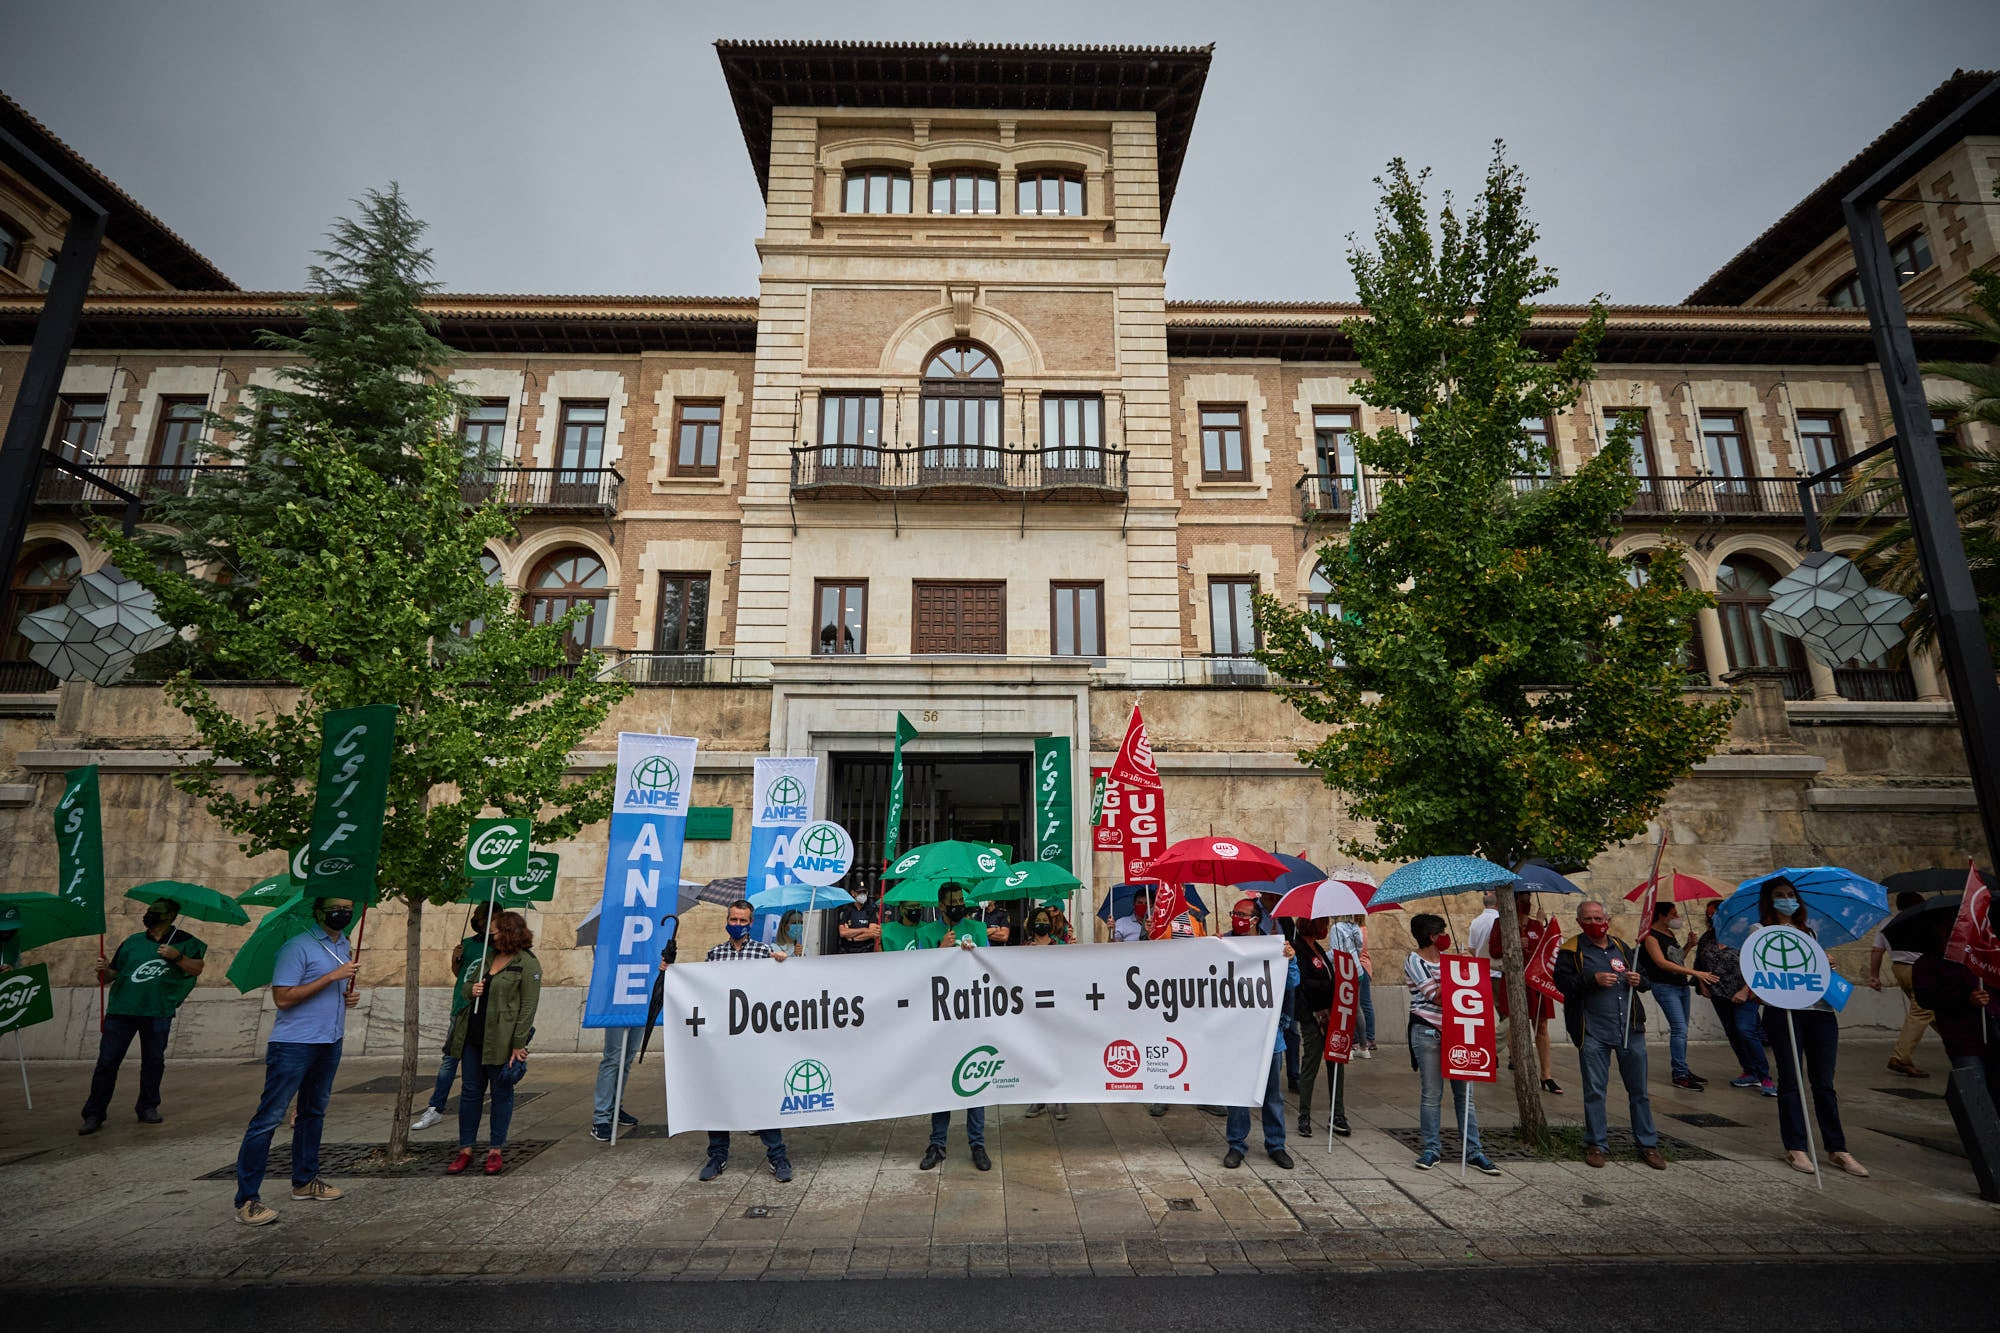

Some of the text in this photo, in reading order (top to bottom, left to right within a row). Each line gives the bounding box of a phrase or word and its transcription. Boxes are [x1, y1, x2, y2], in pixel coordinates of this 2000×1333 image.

[924, 711, 938, 722] 56
[624, 789, 680, 806] ANPE
[761, 805, 808, 820] ANPE
[1129, 794, 1158, 858] UGT
[480, 838, 524, 855] CSIF
[792, 855, 846, 874] ANPE
[612, 822, 663, 1005] ANPE
[1751, 971, 1824, 992] ANPE
[0, 984, 42, 1012] CSIF
[685, 1006, 706, 1037] +
[729, 988, 865, 1036] Docentes
[931, 972, 1025, 1022] Ratios
[1035, 989, 1055, 1009] =
[1085, 982, 1105, 1011] +
[1126, 959, 1274, 1023] Seguridad
[1337, 955, 1355, 1031] UGT
[1449, 960, 1485, 1044] UGT
[1108, 1045, 1135, 1062] UGT
[962, 1060, 1005, 1080] CSIF
[992, 1076, 1020, 1084] Granada
[780, 1092, 835, 1112] ANPE
